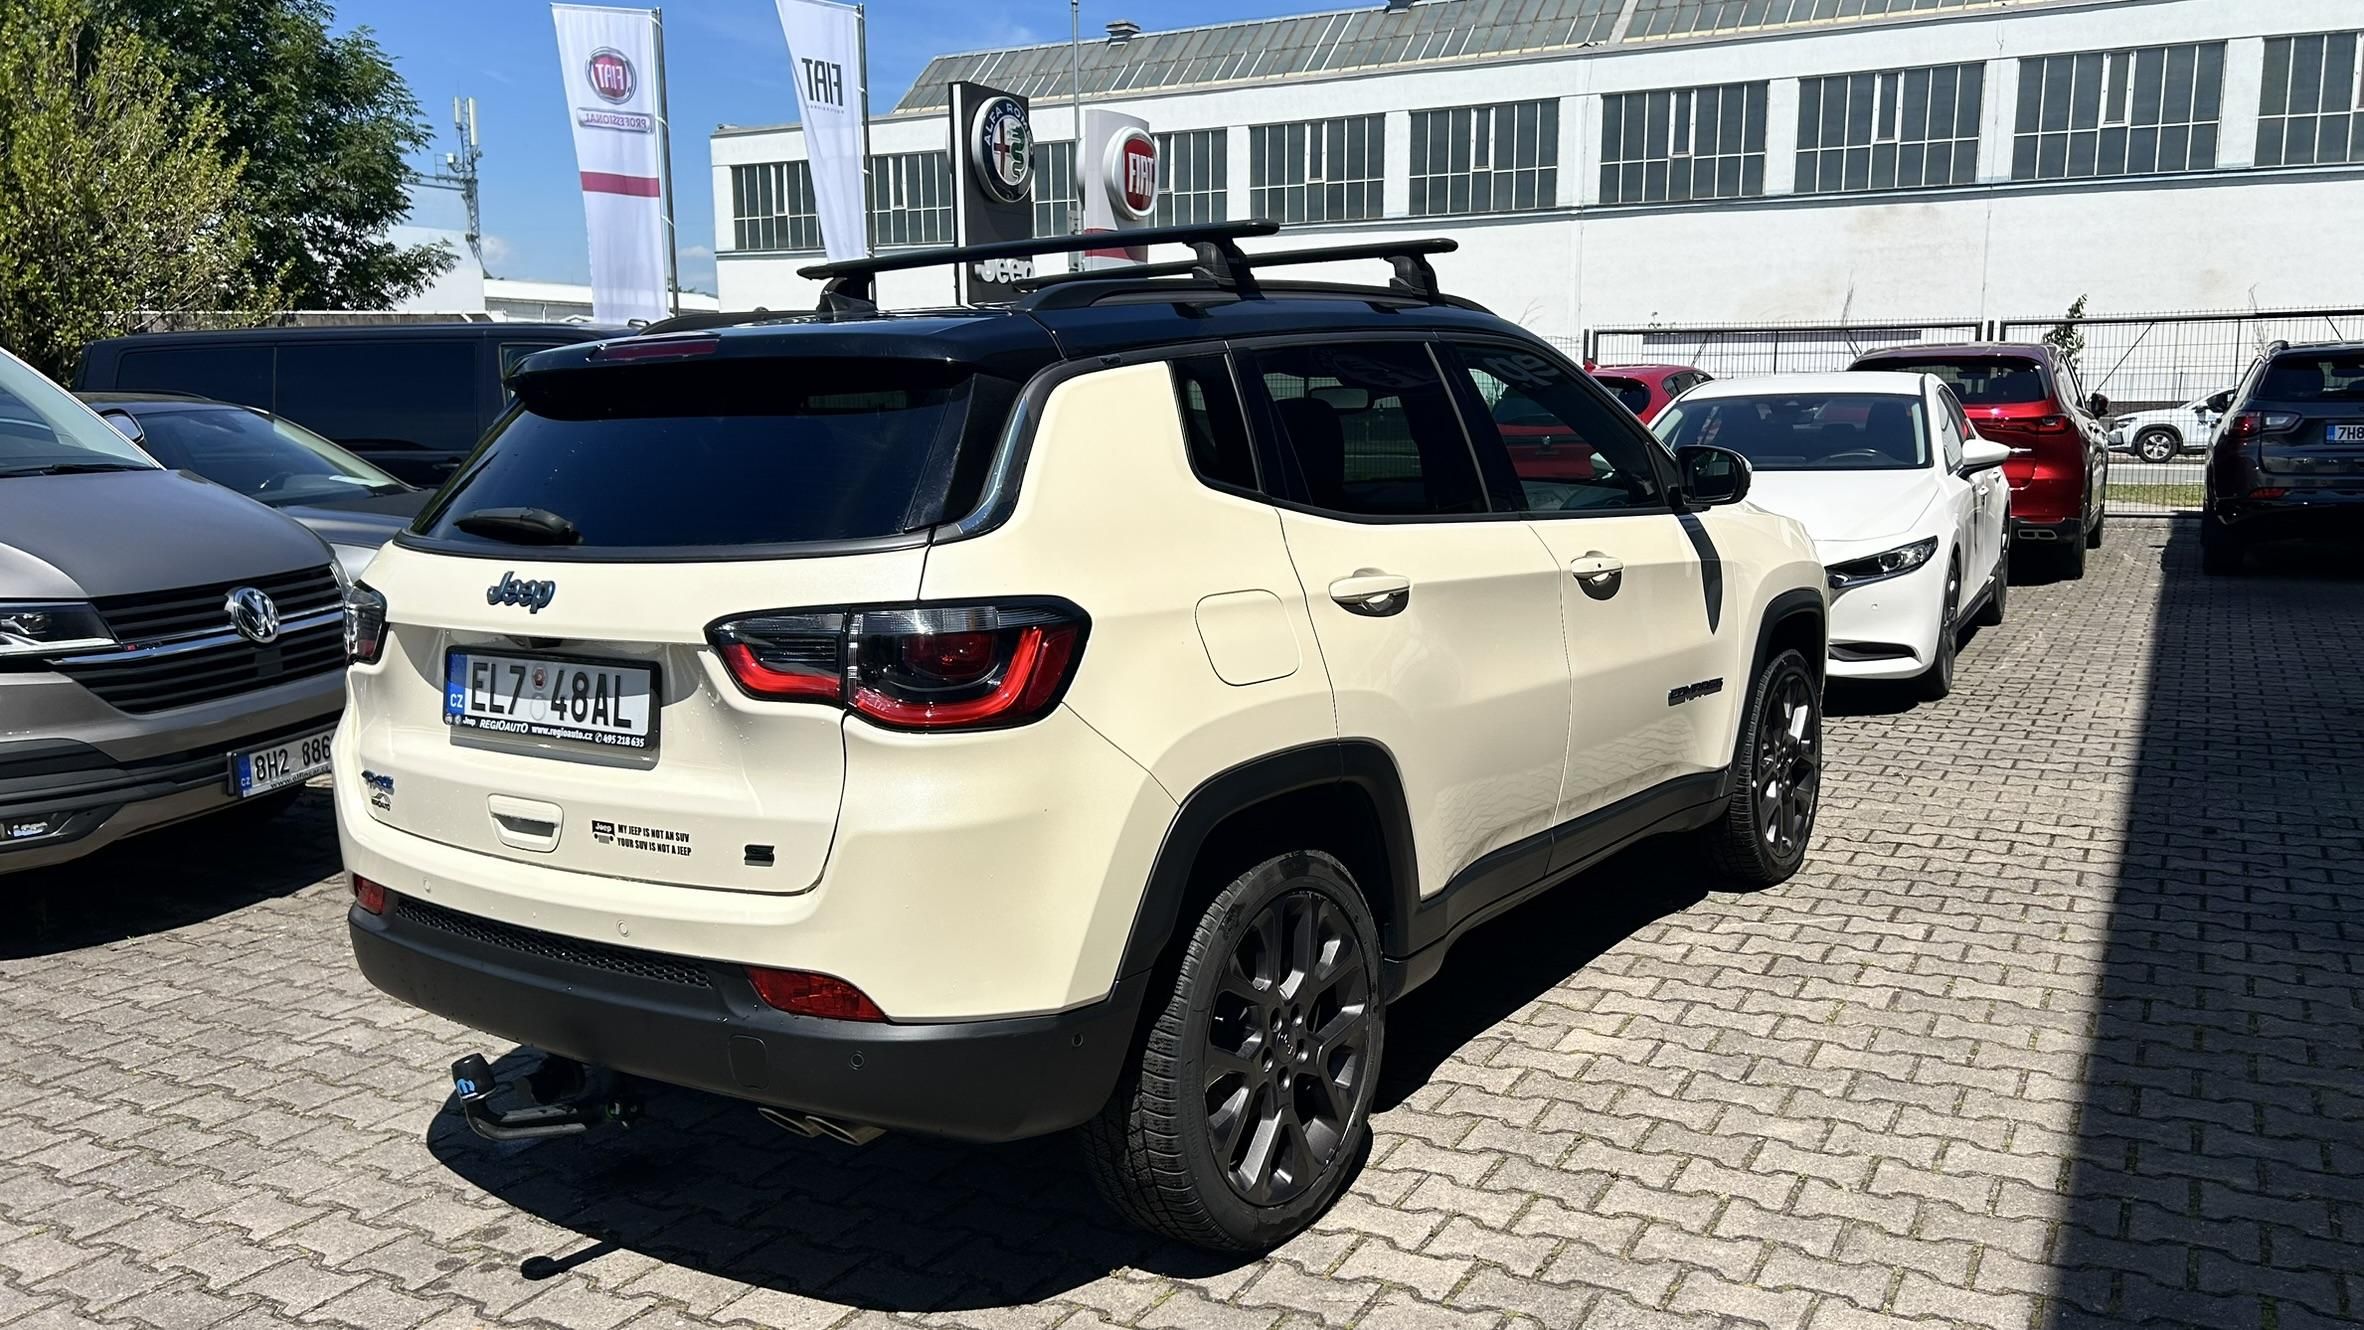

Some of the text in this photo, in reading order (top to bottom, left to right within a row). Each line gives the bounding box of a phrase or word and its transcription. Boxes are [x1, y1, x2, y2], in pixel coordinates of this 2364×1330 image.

[984, 106, 1003, 147] ALFA
[1128, 152, 1156, 197] FIAT
[487, 571, 556, 614] Jeep
[450, 694, 464, 708] CZ
[471, 662, 632, 728] EL7 48AL
[479, 719, 529, 734] REGIOAUTO
[531, 726, 593, 741] www.regioauto.cz
[603, 734, 616, 744] 495
[617, 736, 630, 746] 218
[631, 737, 645, 748] 635
[255, 733, 334, 780] 8H2 886
[595, 823, 612, 833] Jeep
[617, 824, 690, 843] MY JEEP IS NOT AN SUV
[617, 837, 692, 856] YOUR SUV IS NOT A JEEP
